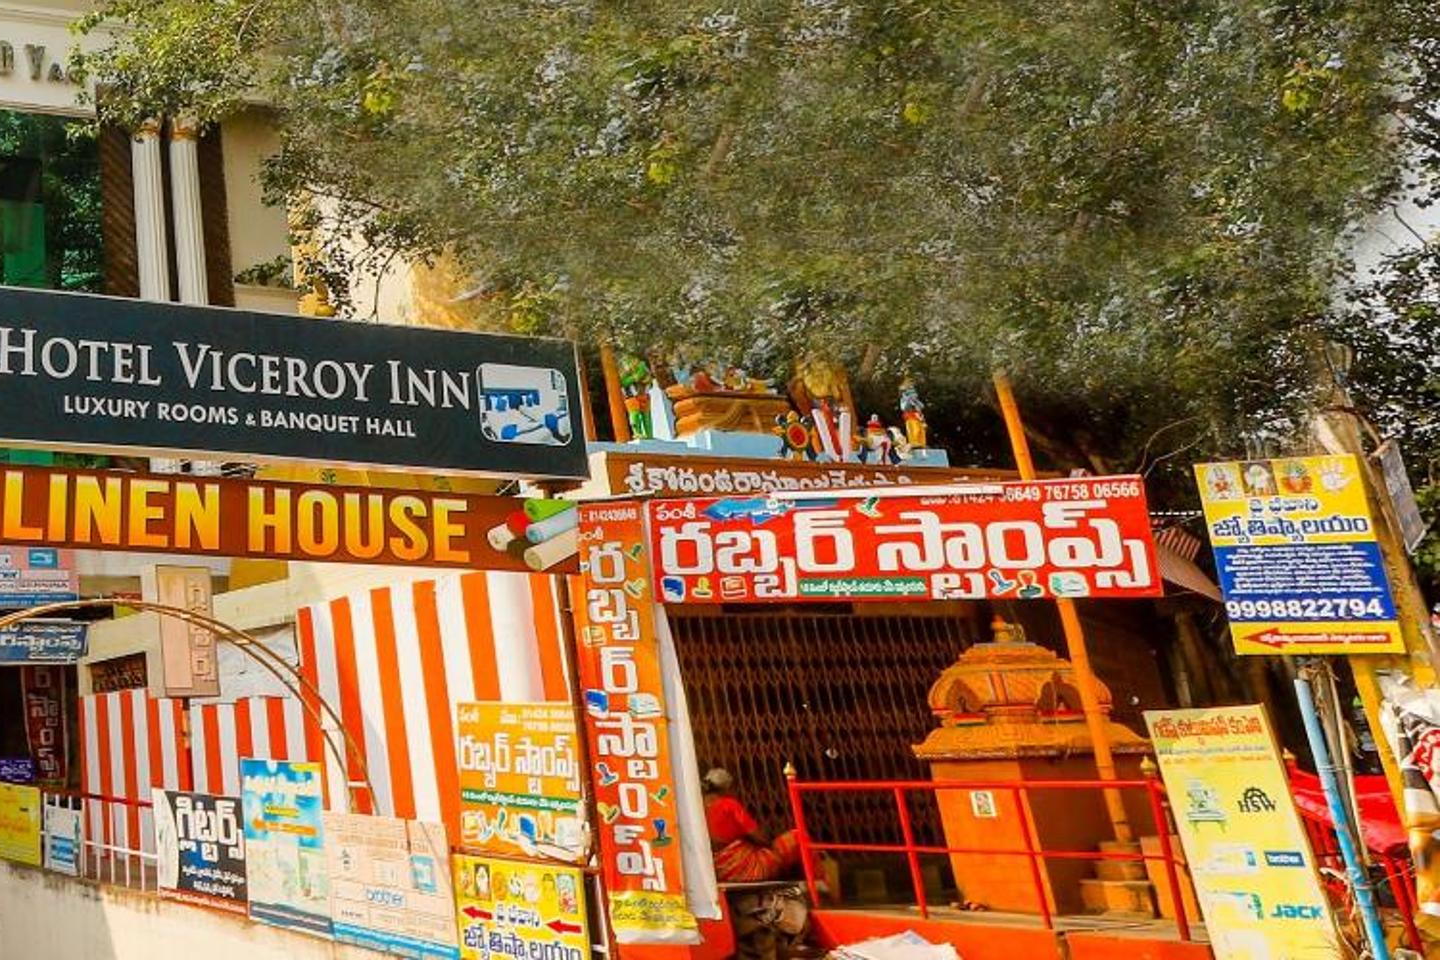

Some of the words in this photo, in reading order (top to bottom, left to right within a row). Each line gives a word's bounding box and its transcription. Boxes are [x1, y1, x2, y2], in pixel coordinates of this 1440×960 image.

[173, 342, 372, 402] VICEROY
[387, 360, 471, 411] INN
[63, 395, 149, 420] LUXURY
[157, 402, 239, 426] ROOMS
[246, 414, 256, 426] &
[260, 409, 360, 436] BANQUET
[365, 416, 416, 438] HALL
[1045, 485, 1088, 500] 76758
[3, 472, 220, 550] LINEN
[246, 485, 469, 563] HOUSE
[660, 507, 854, 597] రబ్బర్
[875, 501, 1145, 599] స్టాంప్స్
[1226, 598, 1384, 618] 9998822794
[1237, 798, 1276, 813] HSW
